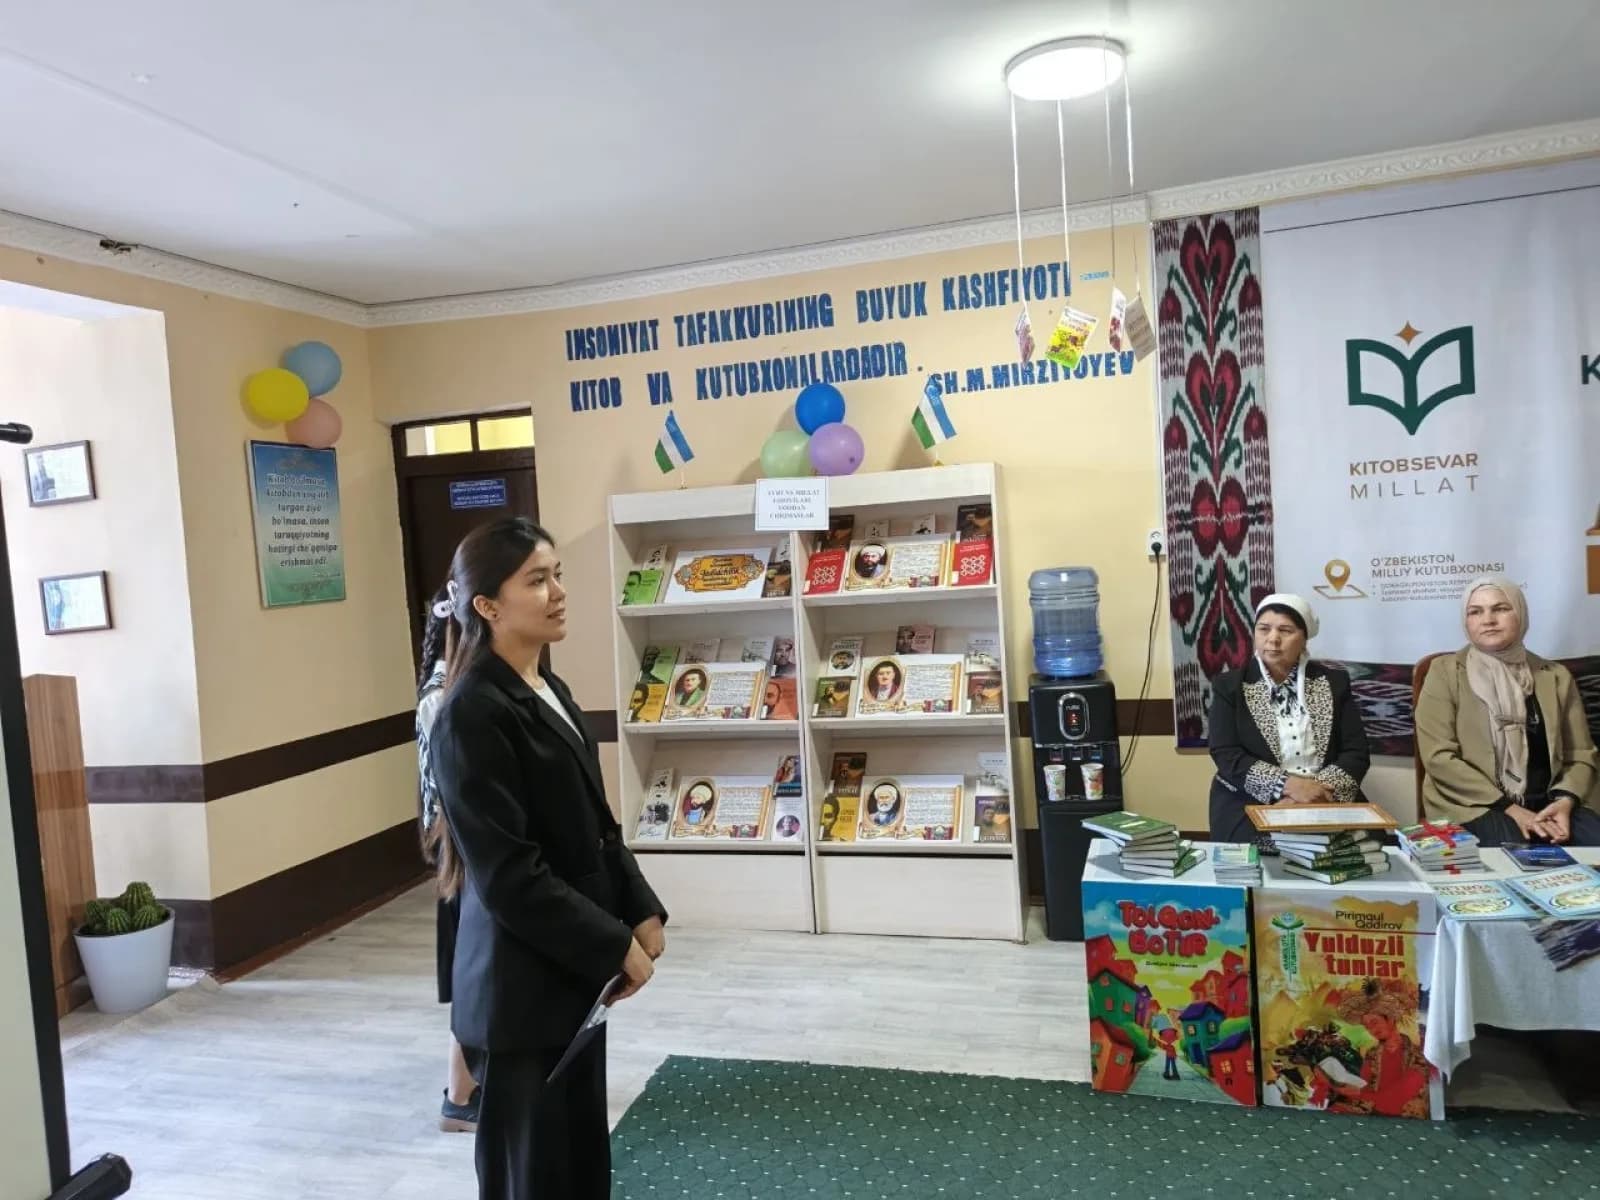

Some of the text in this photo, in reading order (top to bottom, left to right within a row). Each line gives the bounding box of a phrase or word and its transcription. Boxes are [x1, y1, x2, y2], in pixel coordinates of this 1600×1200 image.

[673, 293, 835, 347] TAFAKKURINING
[855, 281, 928, 323] BUYUK
[942, 260, 1071, 311] KASHFIYOTI
[570, 377, 622, 412] KITOB
[647, 371, 673, 406] VA
[1349, 453, 1478, 476] KITOBSEVAR
[1350, 474, 1480, 500] MILLAT
[1371, 562, 1505, 578] MILLIY KUTUBXONASI
[1303, 931, 1404, 956] Yulduzli
[1324, 953, 1405, 978] tunlar
